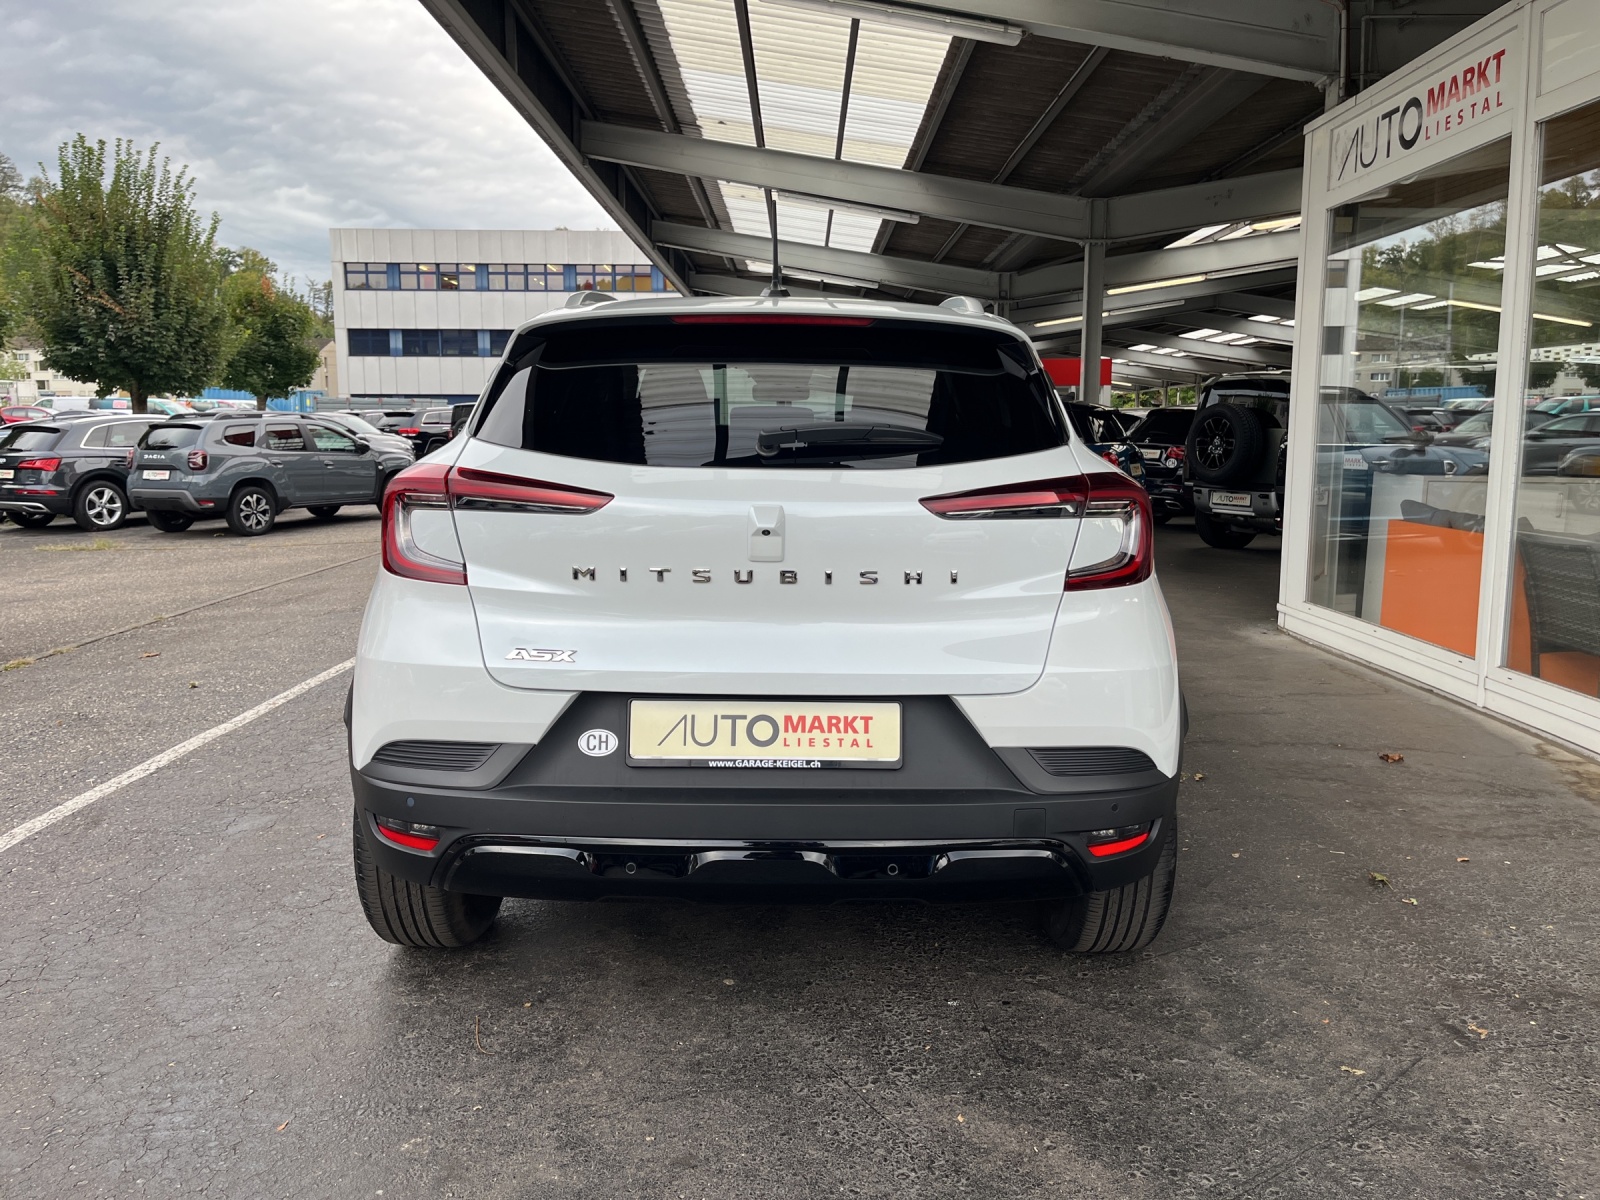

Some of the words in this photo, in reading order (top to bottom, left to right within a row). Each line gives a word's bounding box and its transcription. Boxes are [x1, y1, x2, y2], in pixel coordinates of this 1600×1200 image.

[1338, 96, 1424, 181] AUTO
[1426, 48, 1506, 118] MARKT
[1425, 91, 1503, 141] LIESTAL
[572, 565, 958, 585] MITSUBISHI
[504, 647, 578, 663] ASX
[657, 714, 780, 747] AUTO
[783, 715, 873, 735] MARKT
[586, 733, 609, 752] CH
[783, 737, 873, 748] LIESTAL
[708, 759, 821, 769] www.GARAGE-KEIGEL.ch
